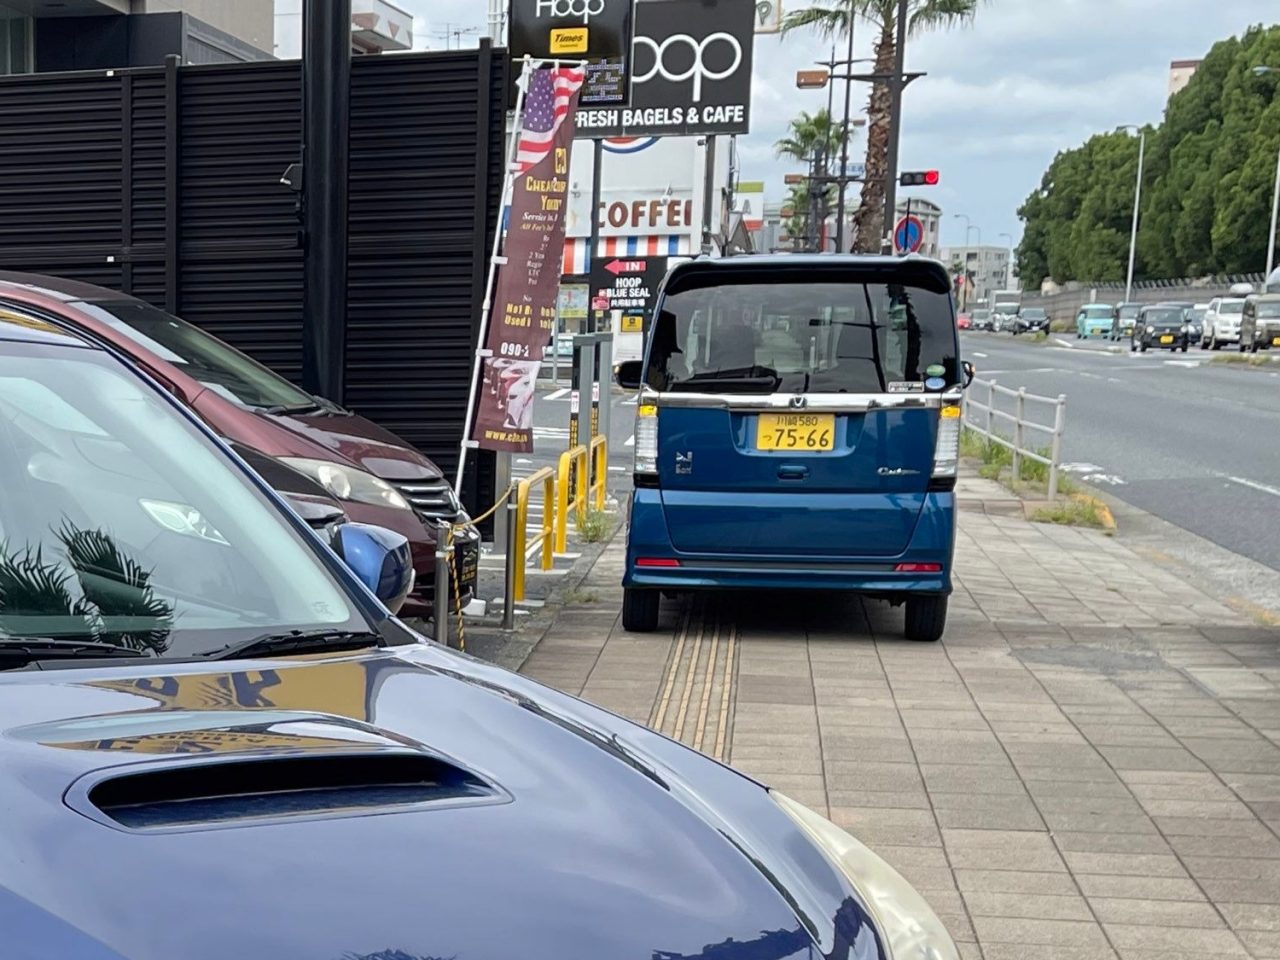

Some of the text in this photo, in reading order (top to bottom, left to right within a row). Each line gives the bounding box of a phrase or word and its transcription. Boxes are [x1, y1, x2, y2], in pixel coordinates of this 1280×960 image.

[555, 33, 584, 43] Times
[622, 107, 684, 127] BAGELS
[686, 107, 700, 124] &
[703, 105, 745, 124] CAFE
[625, 261, 641, 271] IN
[615, 277, 642, 288] HOOP
[606, 287, 651, 298] BLUE SEAL
[798, 415, 819, 427] 580
[774, 428, 830, 448] 75-66
